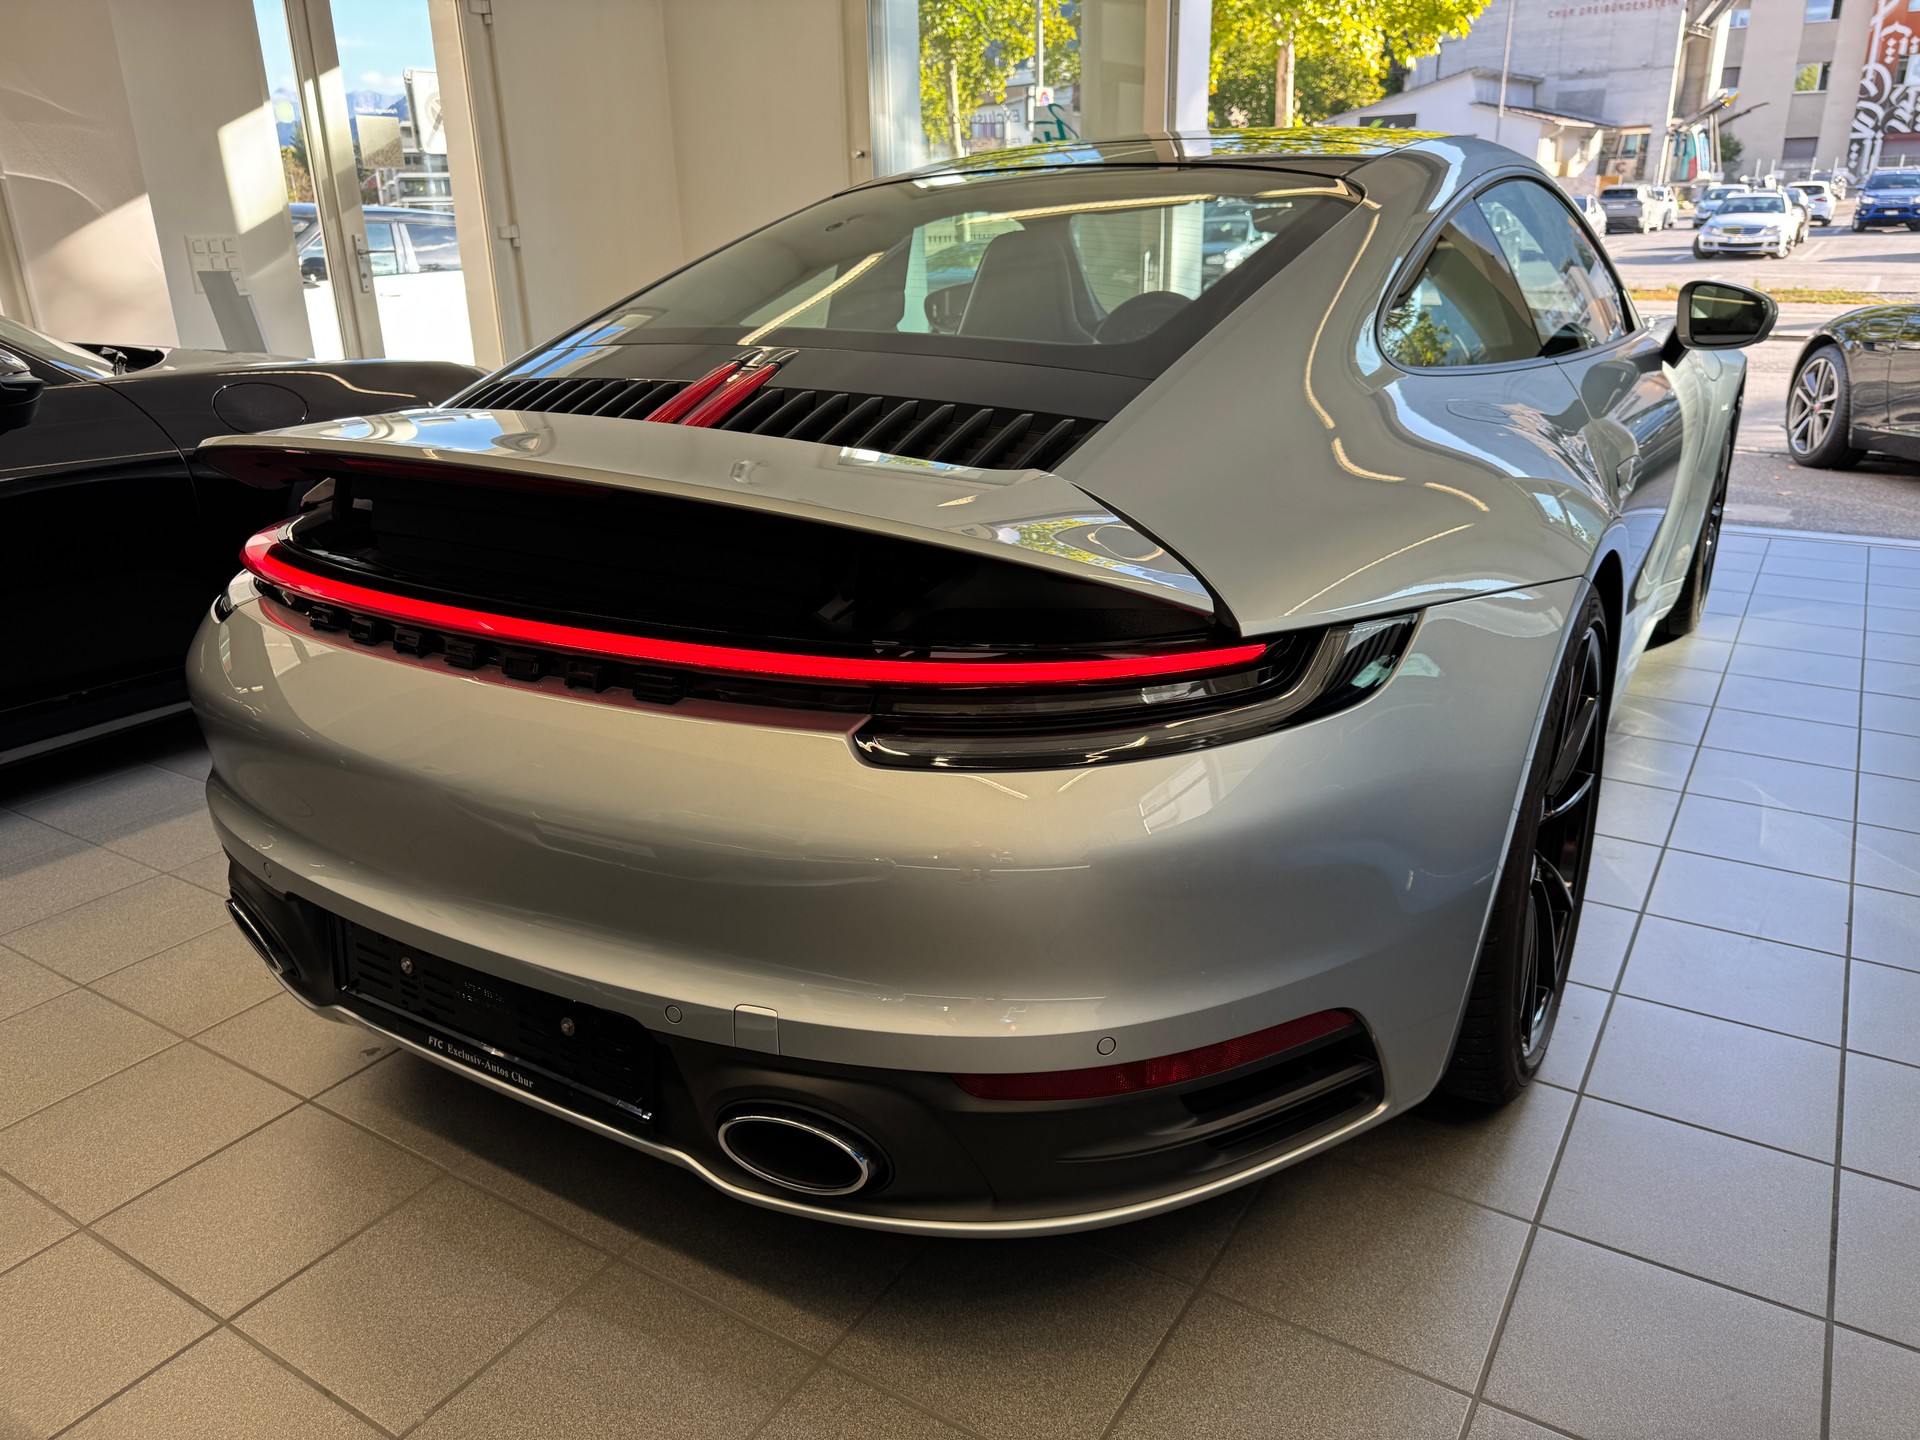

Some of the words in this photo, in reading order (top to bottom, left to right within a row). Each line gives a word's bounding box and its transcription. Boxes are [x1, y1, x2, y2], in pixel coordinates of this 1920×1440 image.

[428, 1035, 443, 1050] FTC
[447, 1044, 509, 1078] Exclusiv-Autos
[511, 1071, 534, 1088] Chur
